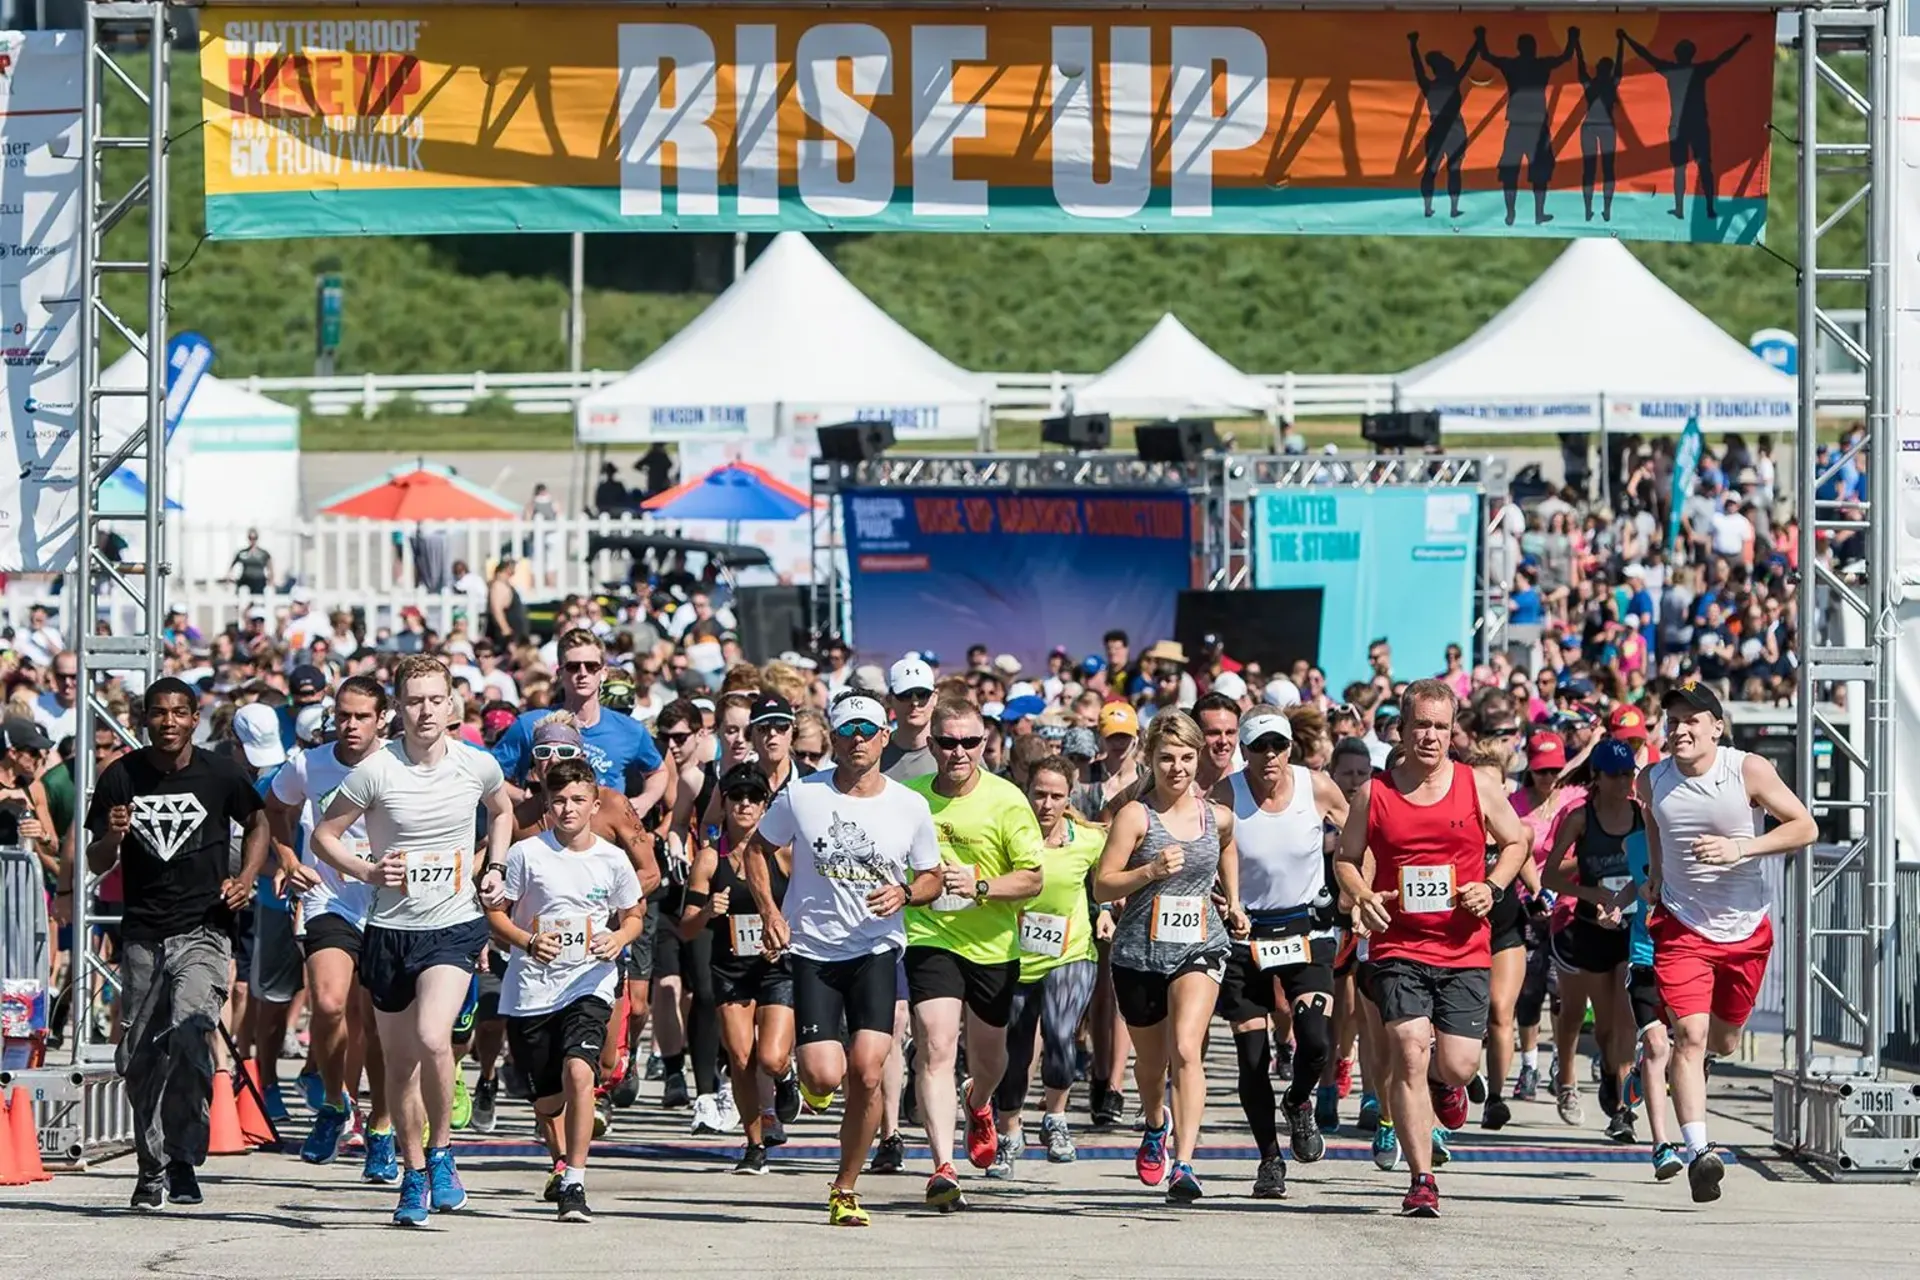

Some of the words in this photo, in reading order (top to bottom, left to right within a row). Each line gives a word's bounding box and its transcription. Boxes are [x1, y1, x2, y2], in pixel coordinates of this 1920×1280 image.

[224, 20, 421, 53] SHATTERPROOF
[228, 56, 344, 119] RISE
[352, 53, 421, 116] UP
[230, 118, 310, 140] AGAINST
[321, 115, 424, 138] ADDICTION
[617, 23, 989, 217] RISE
[1051, 25, 1268, 217] UP
[230, 138, 270, 178] 5K
[1268, 495, 1337, 526] SHATTER
[1270, 531, 1299, 562] THE
[410, 866, 453, 882] 1277
[1406, 882, 1448, 897] 1323
[1161, 912, 1200, 928] 1203
[1024, 925, 1063, 944] 1242
[1261, 943, 1302, 957] 1013
